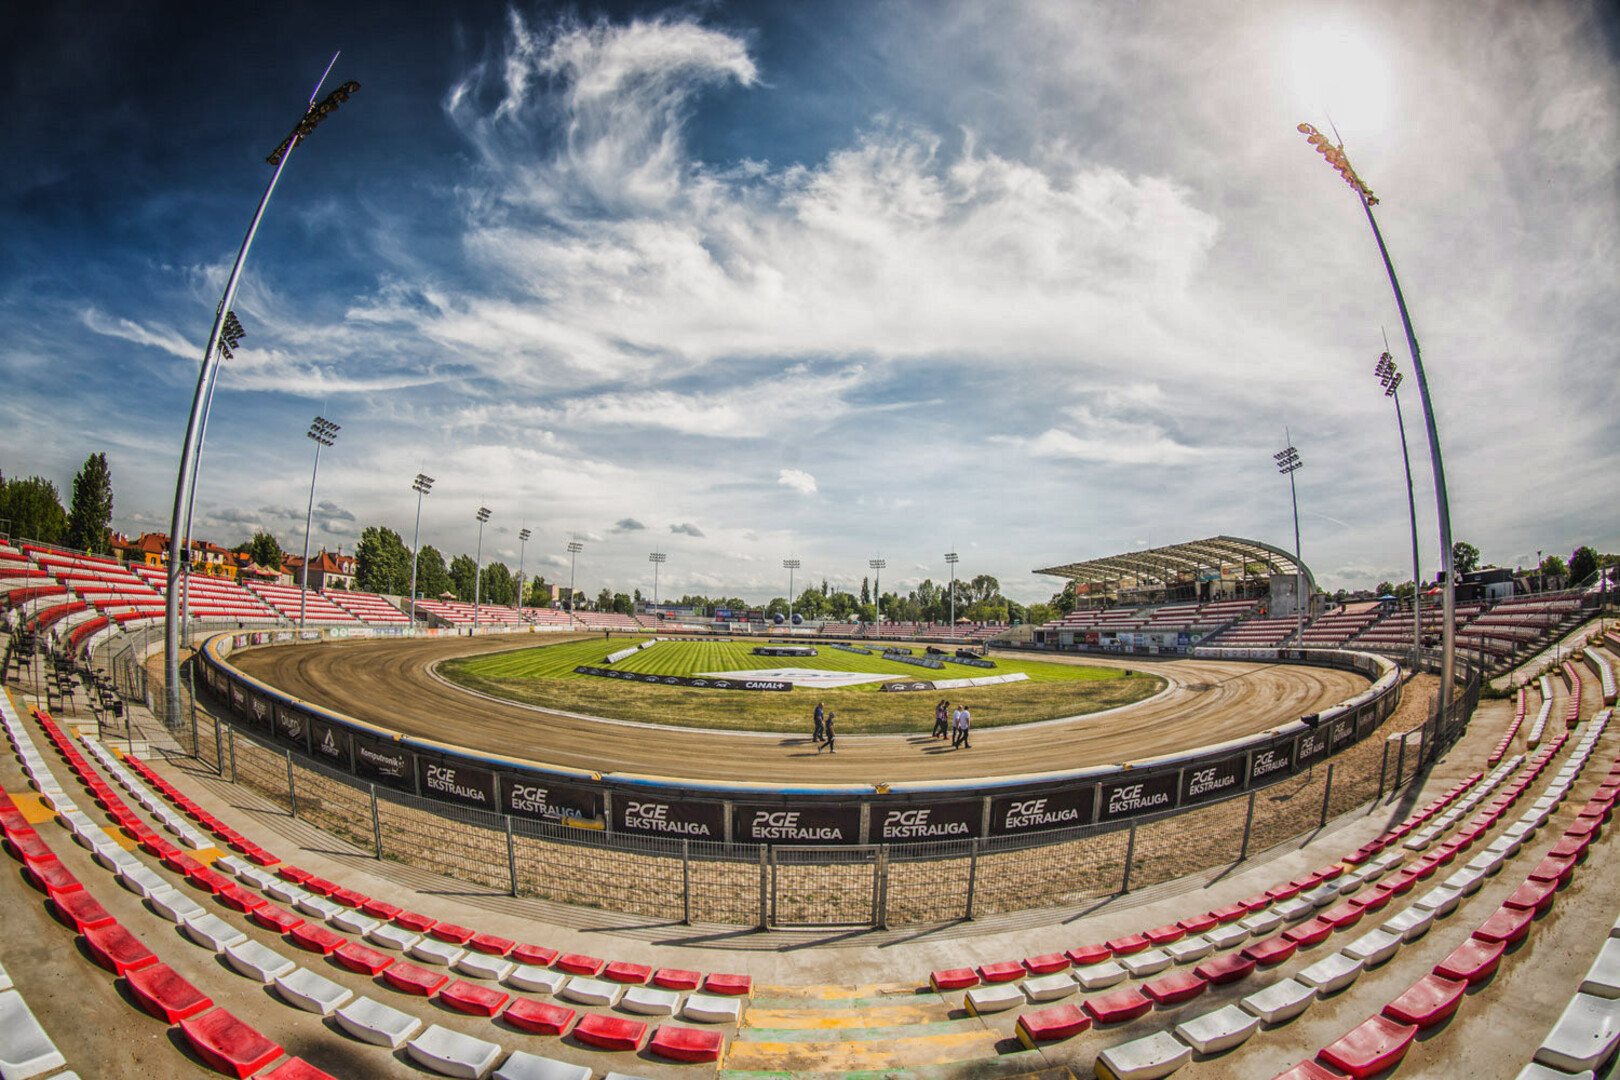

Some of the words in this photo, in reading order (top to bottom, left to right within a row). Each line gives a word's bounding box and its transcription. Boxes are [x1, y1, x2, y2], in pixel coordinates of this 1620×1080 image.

[746, 681, 784, 690] CANAL+
[361, 747, 398, 766] Komputronik
[1254, 750, 1276, 766] PGE
[427, 764, 456, 782] PGE
[1254, 757, 1288, 777] EKSTRALIGA
[1190, 768, 1217, 786] PGE
[1190, 774, 1235, 796] EKSTRALIGA
[428, 777, 486, 802] EKSTRALIGA
[512, 784, 548, 802] PGE
[1110, 784, 1144, 802] PGE
[512, 798, 582, 818] EKSTRALIGA
[625, 802, 669, 820] PGE
[1006, 798, 1047, 817] PGE
[1109, 792, 1168, 814] EKSTRALIGA
[625, 816, 710, 836] EKSTRALIGA
[752, 811, 800, 827] PGE
[884, 810, 931, 826] PGE
[1006, 808, 1078, 828] EKSTRALIGA
[752, 827, 842, 840] EKSTRALIGA
[883, 822, 969, 838] EKSTRALIGA
